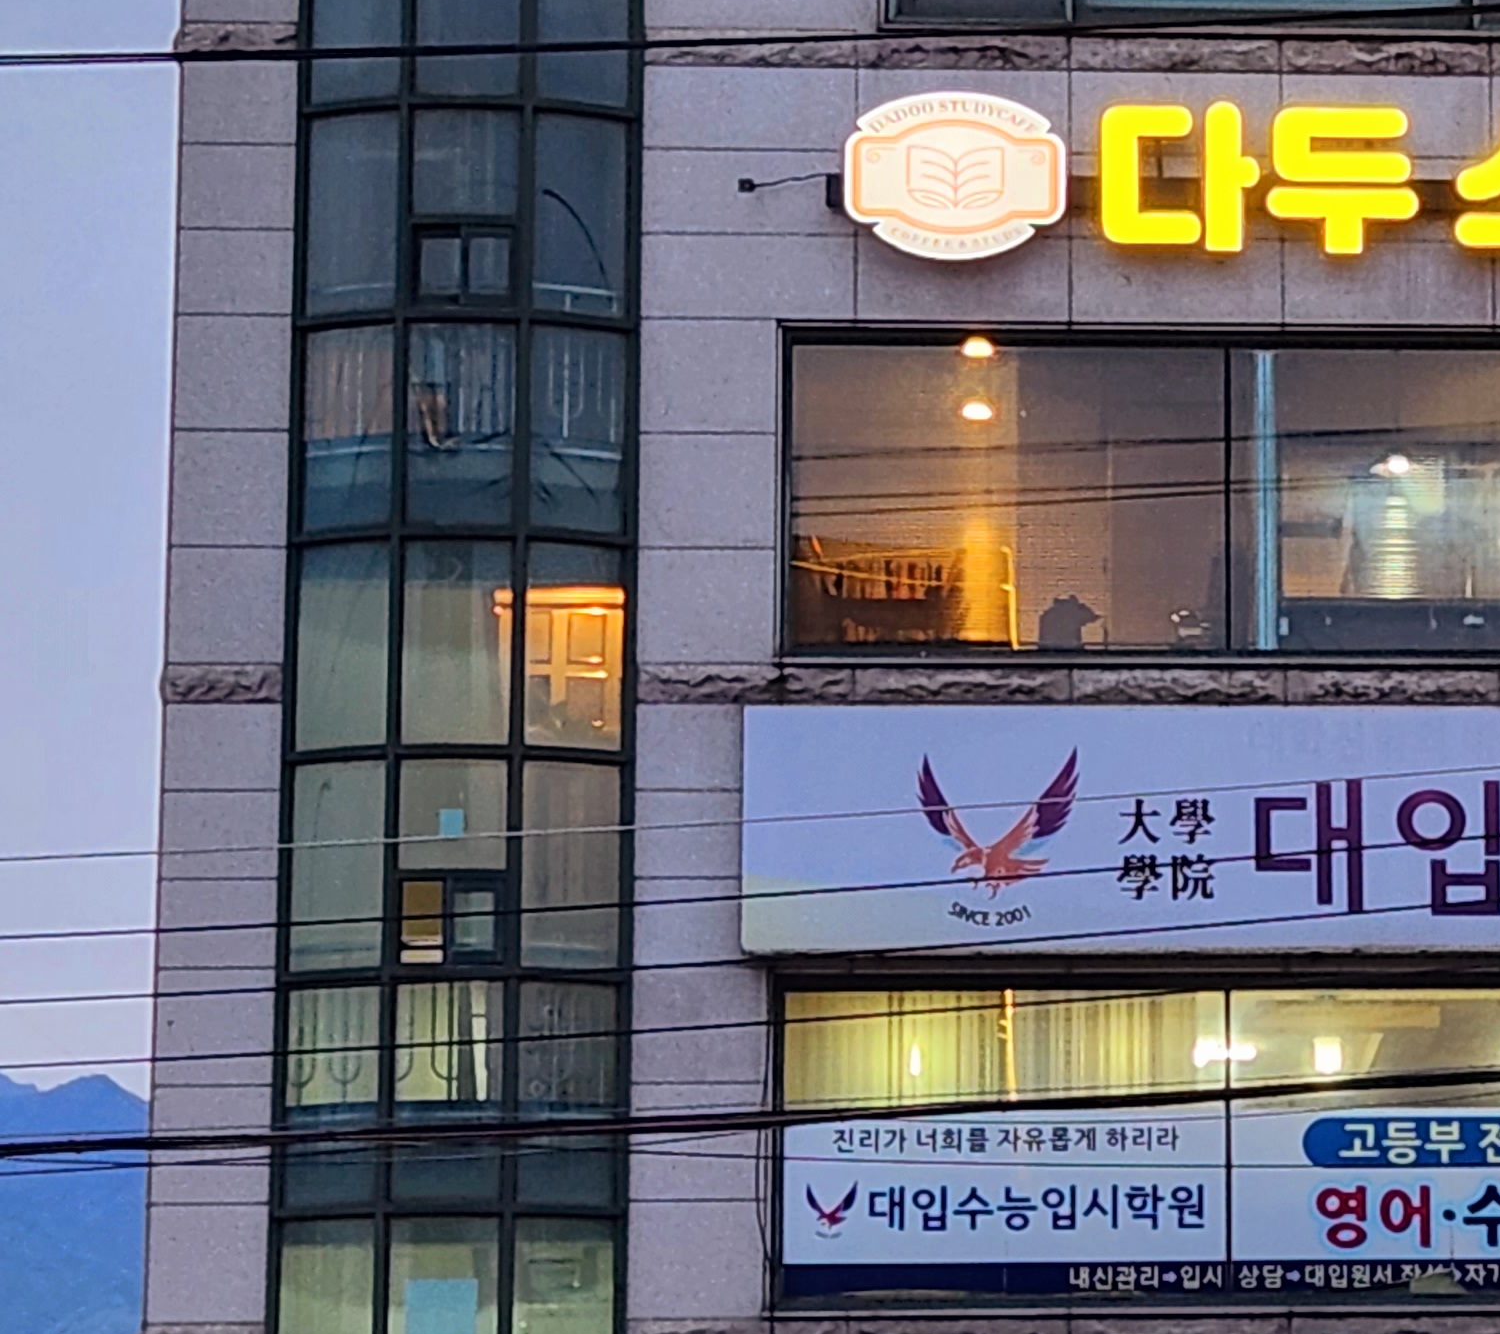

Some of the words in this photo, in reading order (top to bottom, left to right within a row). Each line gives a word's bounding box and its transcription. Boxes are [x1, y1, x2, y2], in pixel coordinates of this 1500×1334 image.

[947, 901, 990, 926] SINCE
[995, 904, 1032, 926] 2001
[832, 1126, 907, 1155] 진리가
[916, 1126, 990, 1155] 너희를
[997, 1126, 1097, 1153] 자유롭게
[1105, 1125, 1180, 1152] 하리라
[1337, 1121, 1467, 1165] 고등부
[867, 1183, 1206, 1232] 대입수능입시학원
[1068, 1265, 1159, 1291] 내신관리
[1180, 1265, 1223, 1289] 입시
[1238, 1265, 1283, 1289] 상담
[1303, 1264, 1394, 1289] 대입원서
